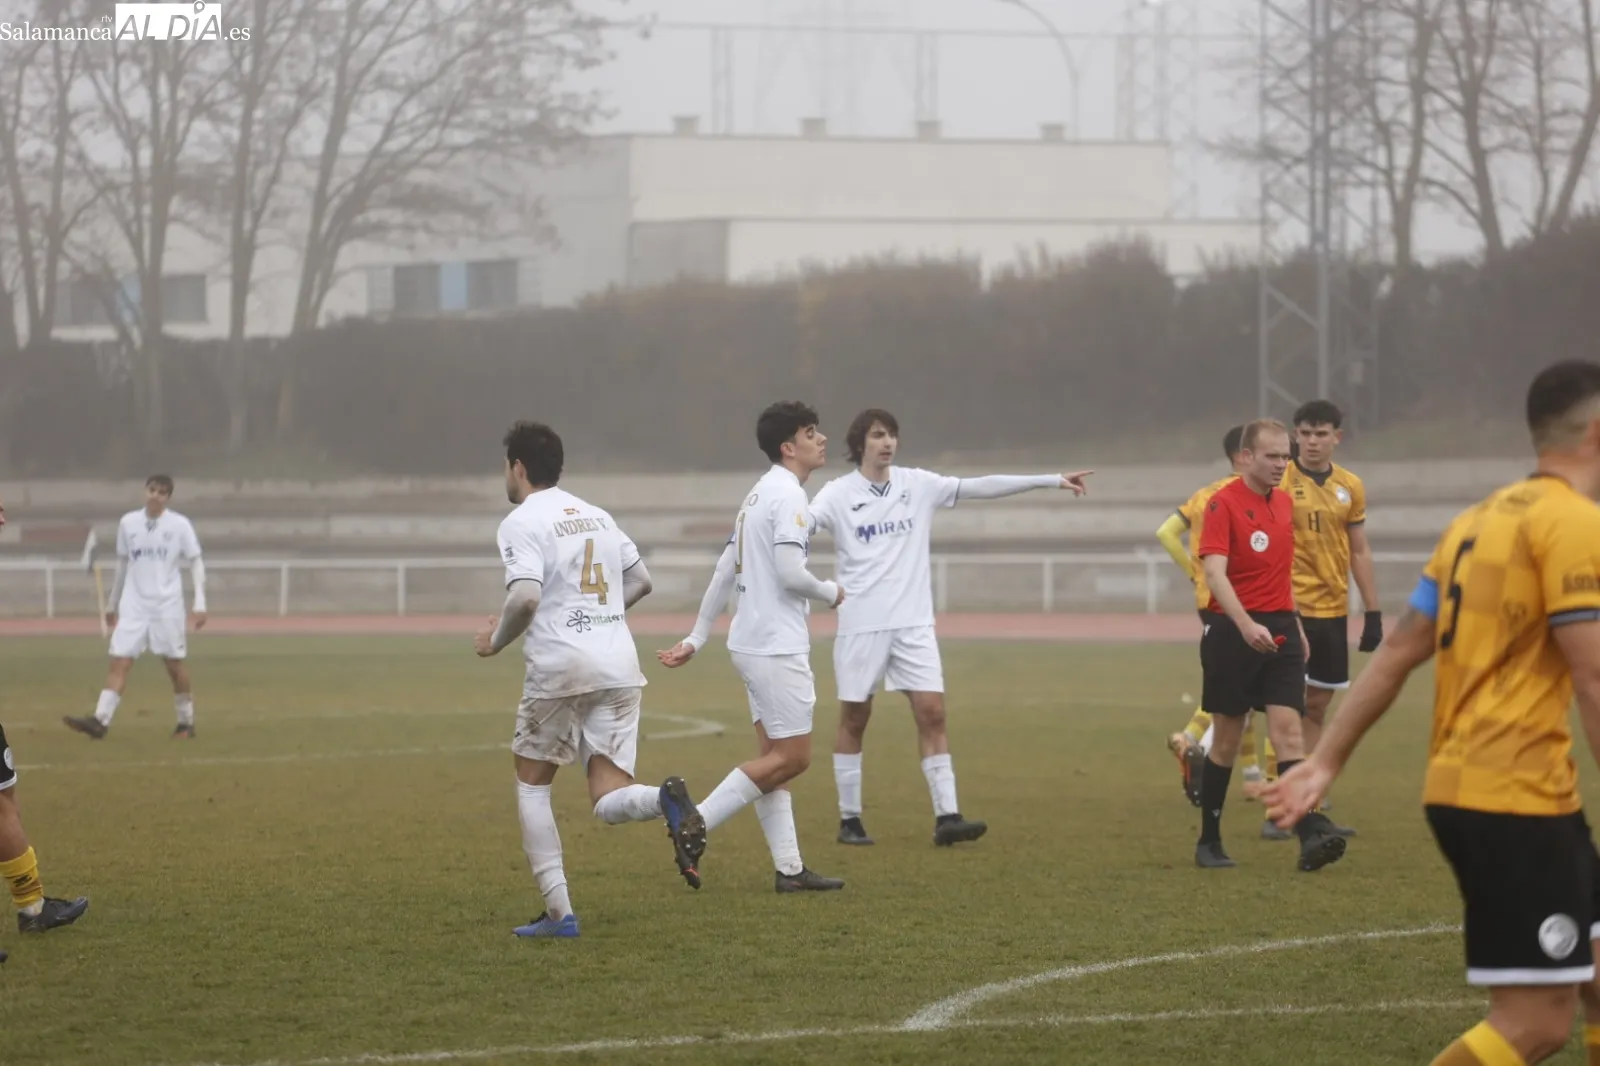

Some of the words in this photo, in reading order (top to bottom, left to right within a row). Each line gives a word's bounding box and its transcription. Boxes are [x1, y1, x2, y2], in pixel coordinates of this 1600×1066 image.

[855, 519, 913, 543] MIRAT
[580, 539, 609, 605] 4
[1440, 537, 1477, 649] 5
